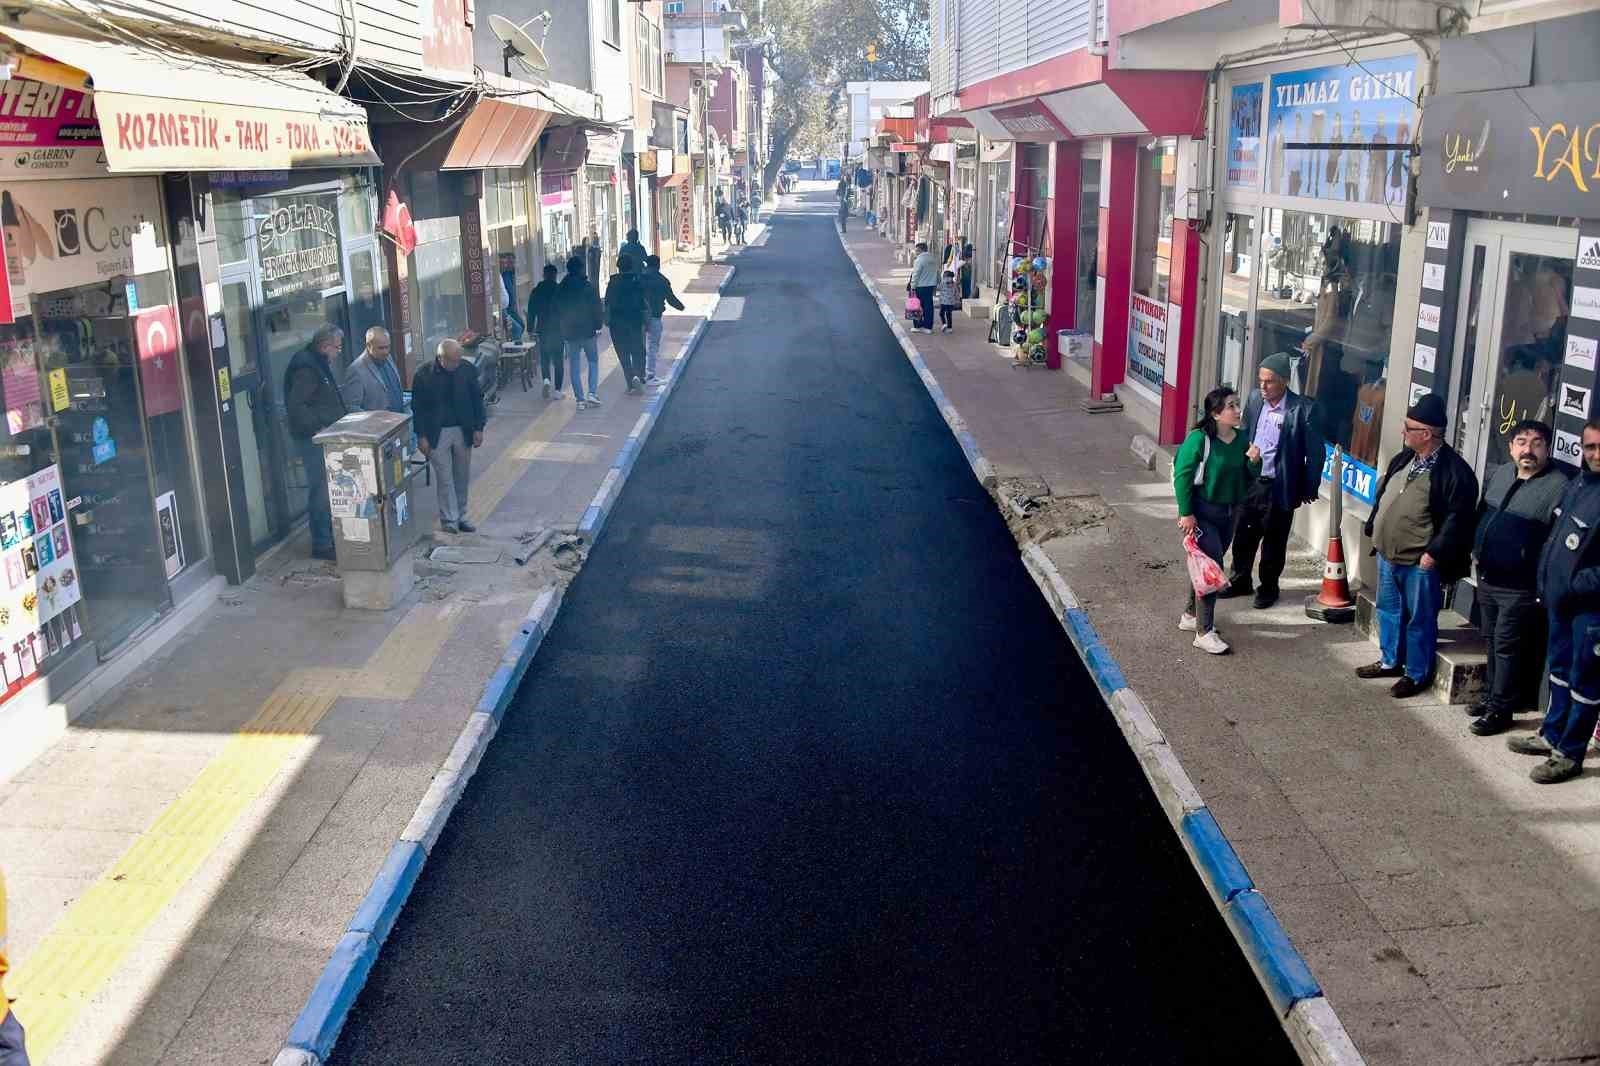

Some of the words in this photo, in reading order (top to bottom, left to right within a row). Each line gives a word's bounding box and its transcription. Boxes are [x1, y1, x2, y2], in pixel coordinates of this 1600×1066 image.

[1276, 80, 1340, 107] YILMAZ
[116, 108, 219, 151] KOZMETİK
[235, 121, 269, 152] TAKI
[286, 121, 320, 151] TOKA
[259, 203, 337, 250] SOLAK
[263, 249, 300, 281] ERKEK
[1556, 436, 1580, 456] D&G
